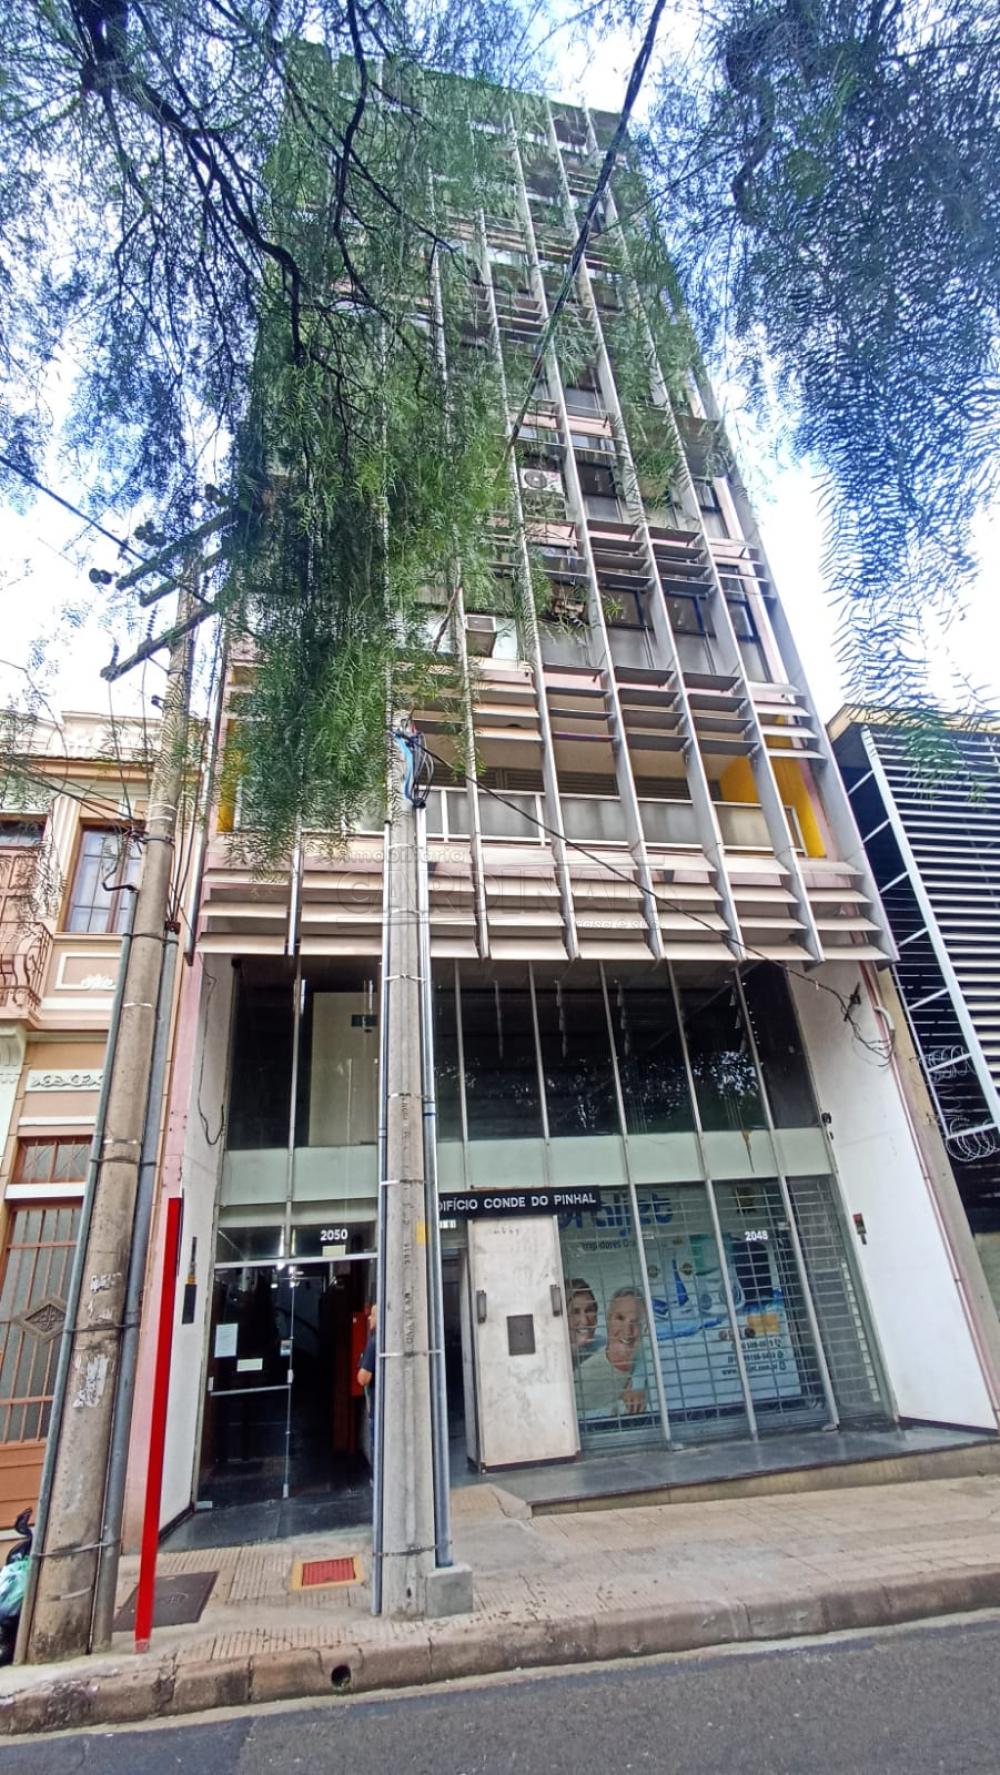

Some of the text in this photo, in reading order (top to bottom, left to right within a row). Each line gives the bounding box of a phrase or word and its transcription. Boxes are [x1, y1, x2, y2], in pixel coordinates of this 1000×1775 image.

[438, 1192, 597, 1212] DIFÍCIO CONDE DO PINHAL
[319, 1228, 349, 1241] 2050
